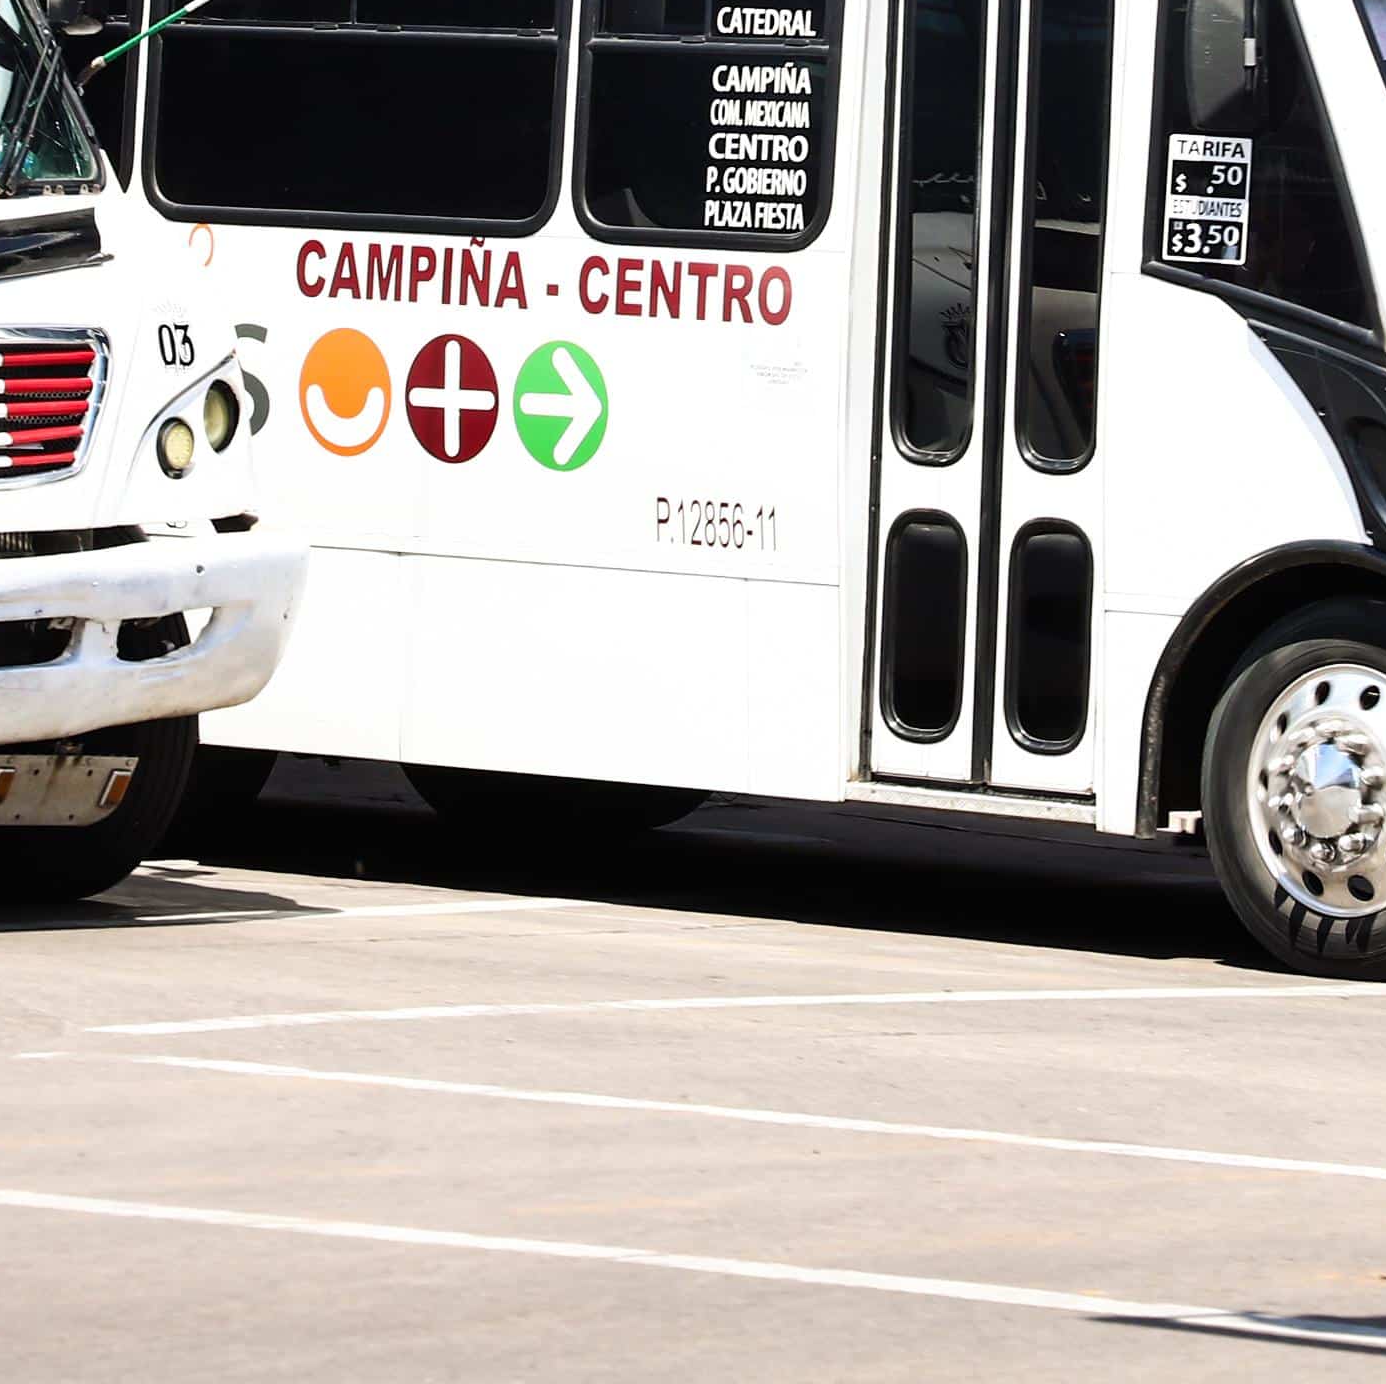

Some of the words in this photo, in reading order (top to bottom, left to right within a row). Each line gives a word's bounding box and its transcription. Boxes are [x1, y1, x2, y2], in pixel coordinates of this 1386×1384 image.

[716, 6, 817, 37] CATEDRAL
[712, 61, 813, 95] CAMPIÑA
[743, 99, 811, 129] MEXICANA
[708, 132, 810, 163] CENTRO
[1176, 139, 1246, 159] TARIFA
[722, 166, 808, 197] GOBIERNO
[703, 199, 753, 228] PLAZA
[754, 201, 805, 231] FIESTA
[1170, 222, 1241, 254] $3.50
[296, 235, 529, 310] CAMPIÑA
[577, 255, 792, 326] CENTRO
[157, 323, 196, 367] 03
[655, 496, 777, 552] P.12856-11
